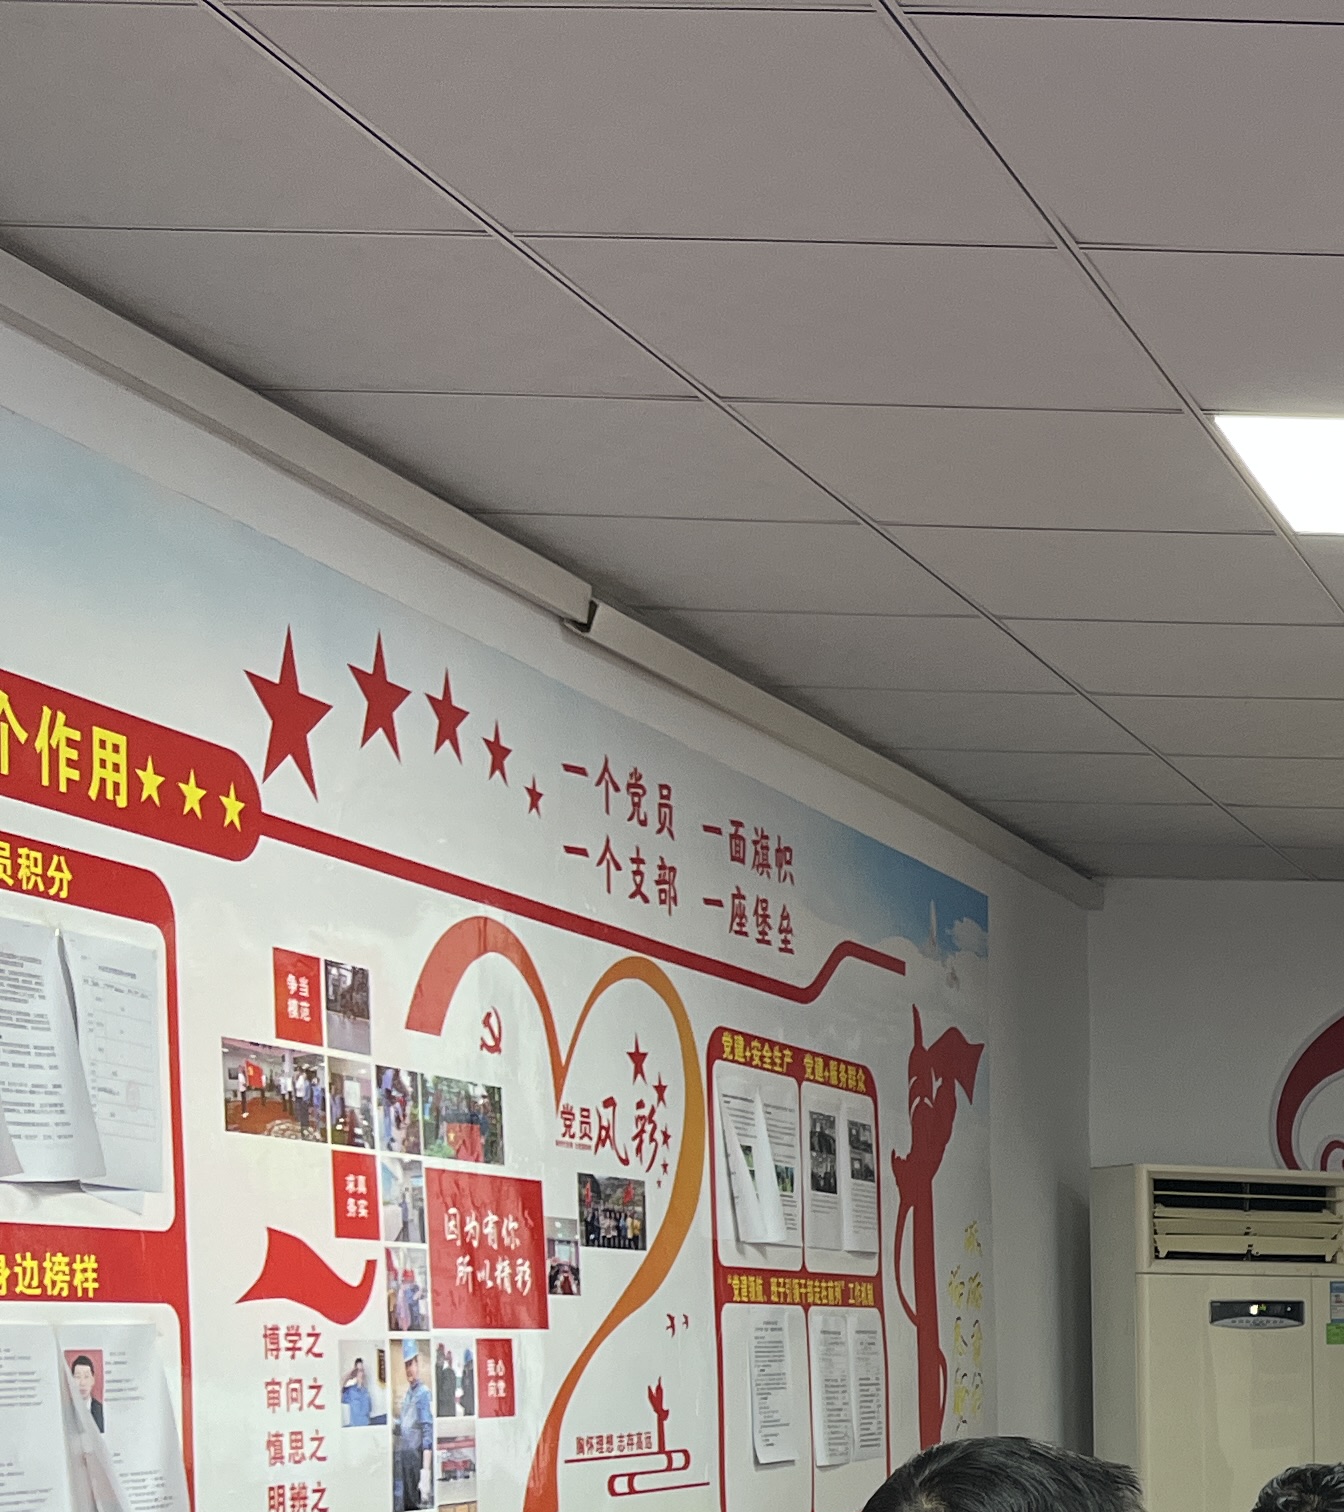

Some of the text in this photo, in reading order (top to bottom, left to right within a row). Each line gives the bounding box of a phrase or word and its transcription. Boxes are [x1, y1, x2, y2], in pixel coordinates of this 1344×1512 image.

[561, 755, 795, 886] 一个党员 一面旗帜
[563, 835, 795, 955] 一个支部 一座堡垒
[721, 1030, 793, 1073] 党建+安全生产
[443, 1207, 521, 1250] 因为有你
[454, 1256, 533, 1298] 所以精彩
[262, 1325, 325, 1360] 博学之
[264, 1377, 326, 1414] 审问之
[265, 1430, 328, 1467] 慎思之
